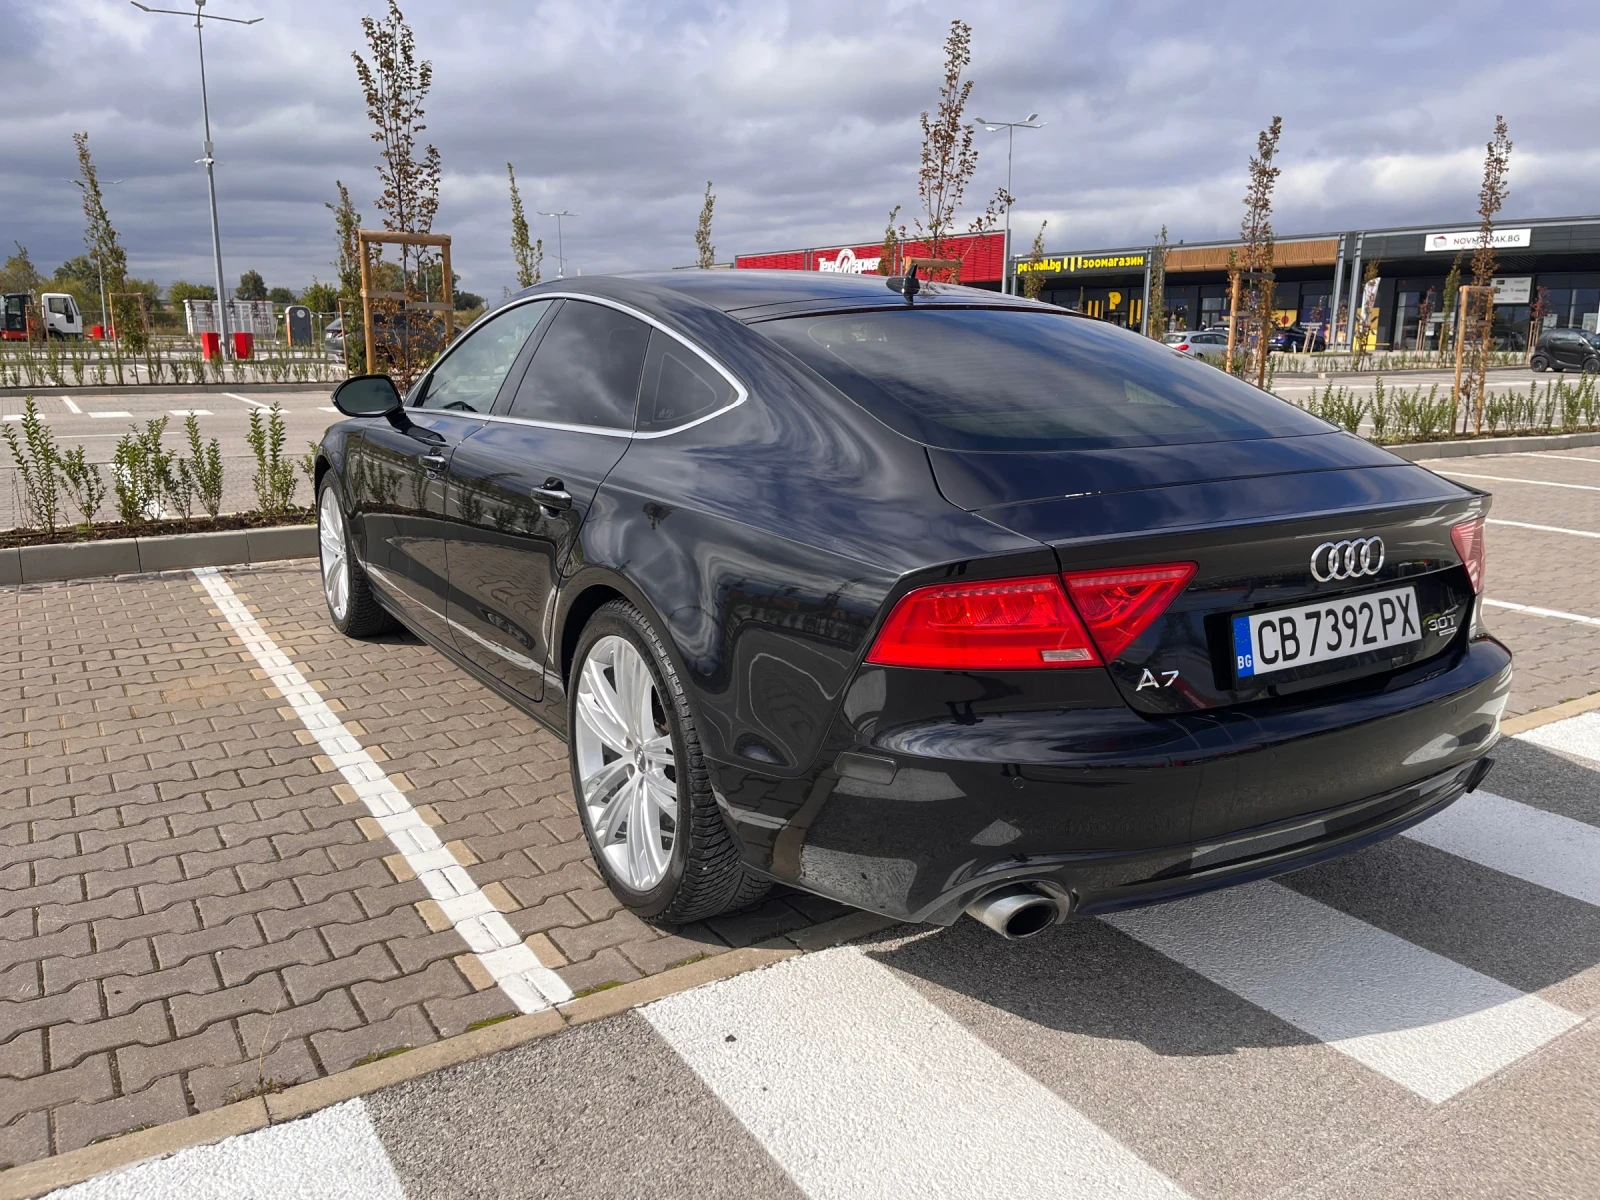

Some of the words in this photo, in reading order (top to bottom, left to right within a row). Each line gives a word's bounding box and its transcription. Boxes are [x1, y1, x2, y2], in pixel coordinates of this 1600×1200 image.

[1083, 256, 1144, 269] зоомагазин
[1237, 654, 1252, 670] BG
[1136, 668, 1180, 691] A7
